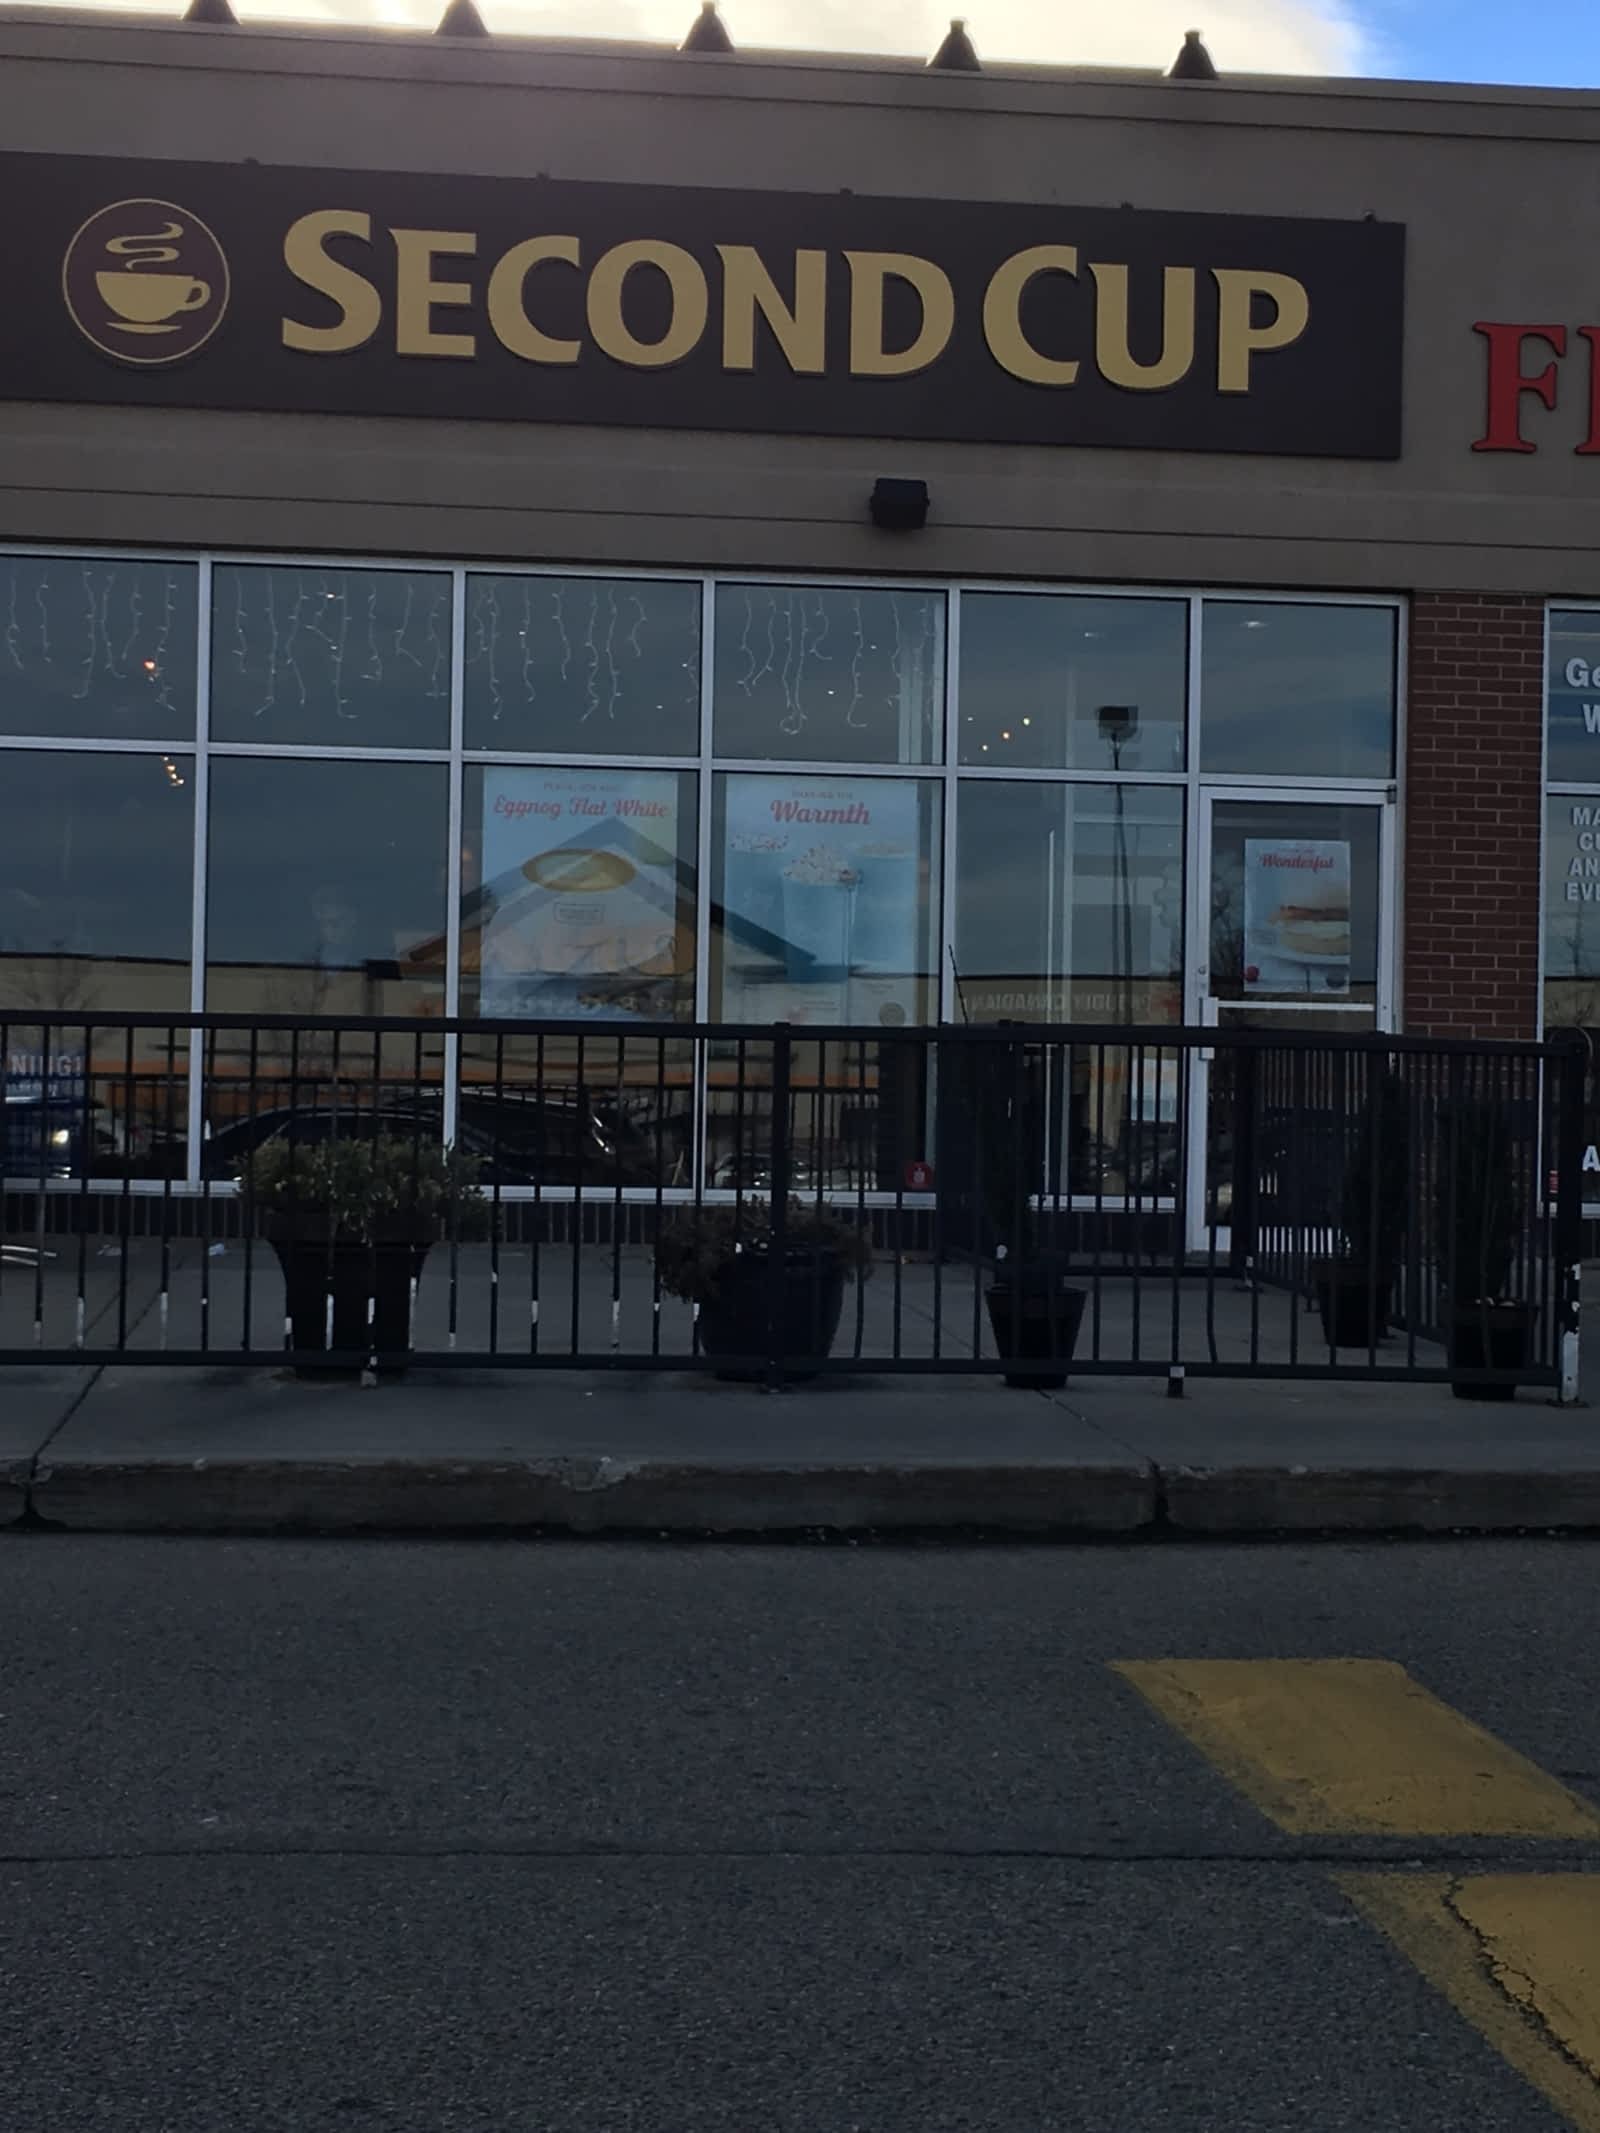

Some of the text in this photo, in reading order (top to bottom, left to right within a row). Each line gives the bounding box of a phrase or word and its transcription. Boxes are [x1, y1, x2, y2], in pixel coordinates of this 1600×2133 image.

[282, 208, 1309, 392] SECOND CUP
[493, 794, 669, 819] Eggnog Flat White
[770, 799, 871, 825] Warmth
[1259, 853, 1334, 872] Wonderful
